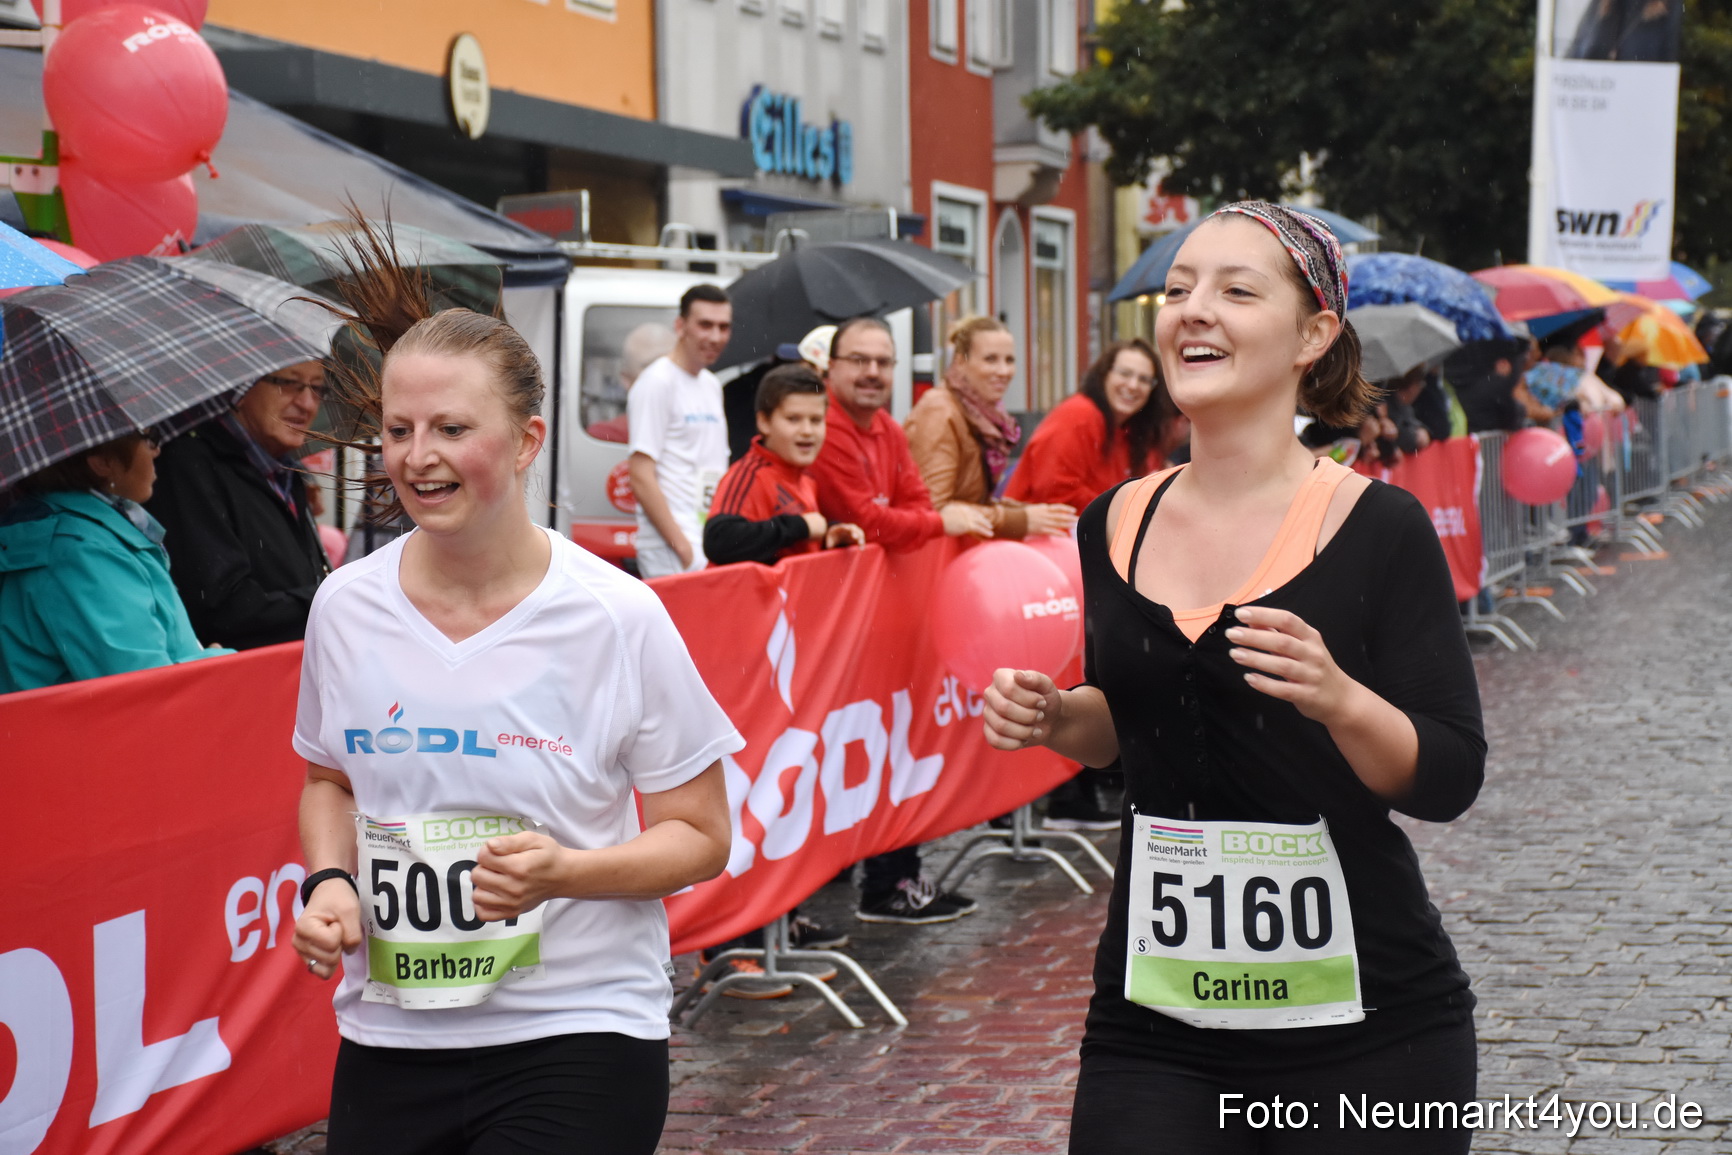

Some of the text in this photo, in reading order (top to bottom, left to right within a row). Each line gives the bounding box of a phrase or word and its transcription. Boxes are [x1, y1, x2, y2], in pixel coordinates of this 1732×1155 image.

[1556, 209, 1621, 236] swn
[423, 816, 526, 843] BOCK
[1147, 841, 1208, 858] NeuerMarkt
[1221, 830, 1327, 858] BOCK
[1221, 855, 1329, 867] inspired by smart concepts
[371, 858, 519, 932] 500
[1151, 871, 1333, 952] 5160
[395, 952, 496, 980] Barbara
[1193, 971, 1288, 1001] Carina
